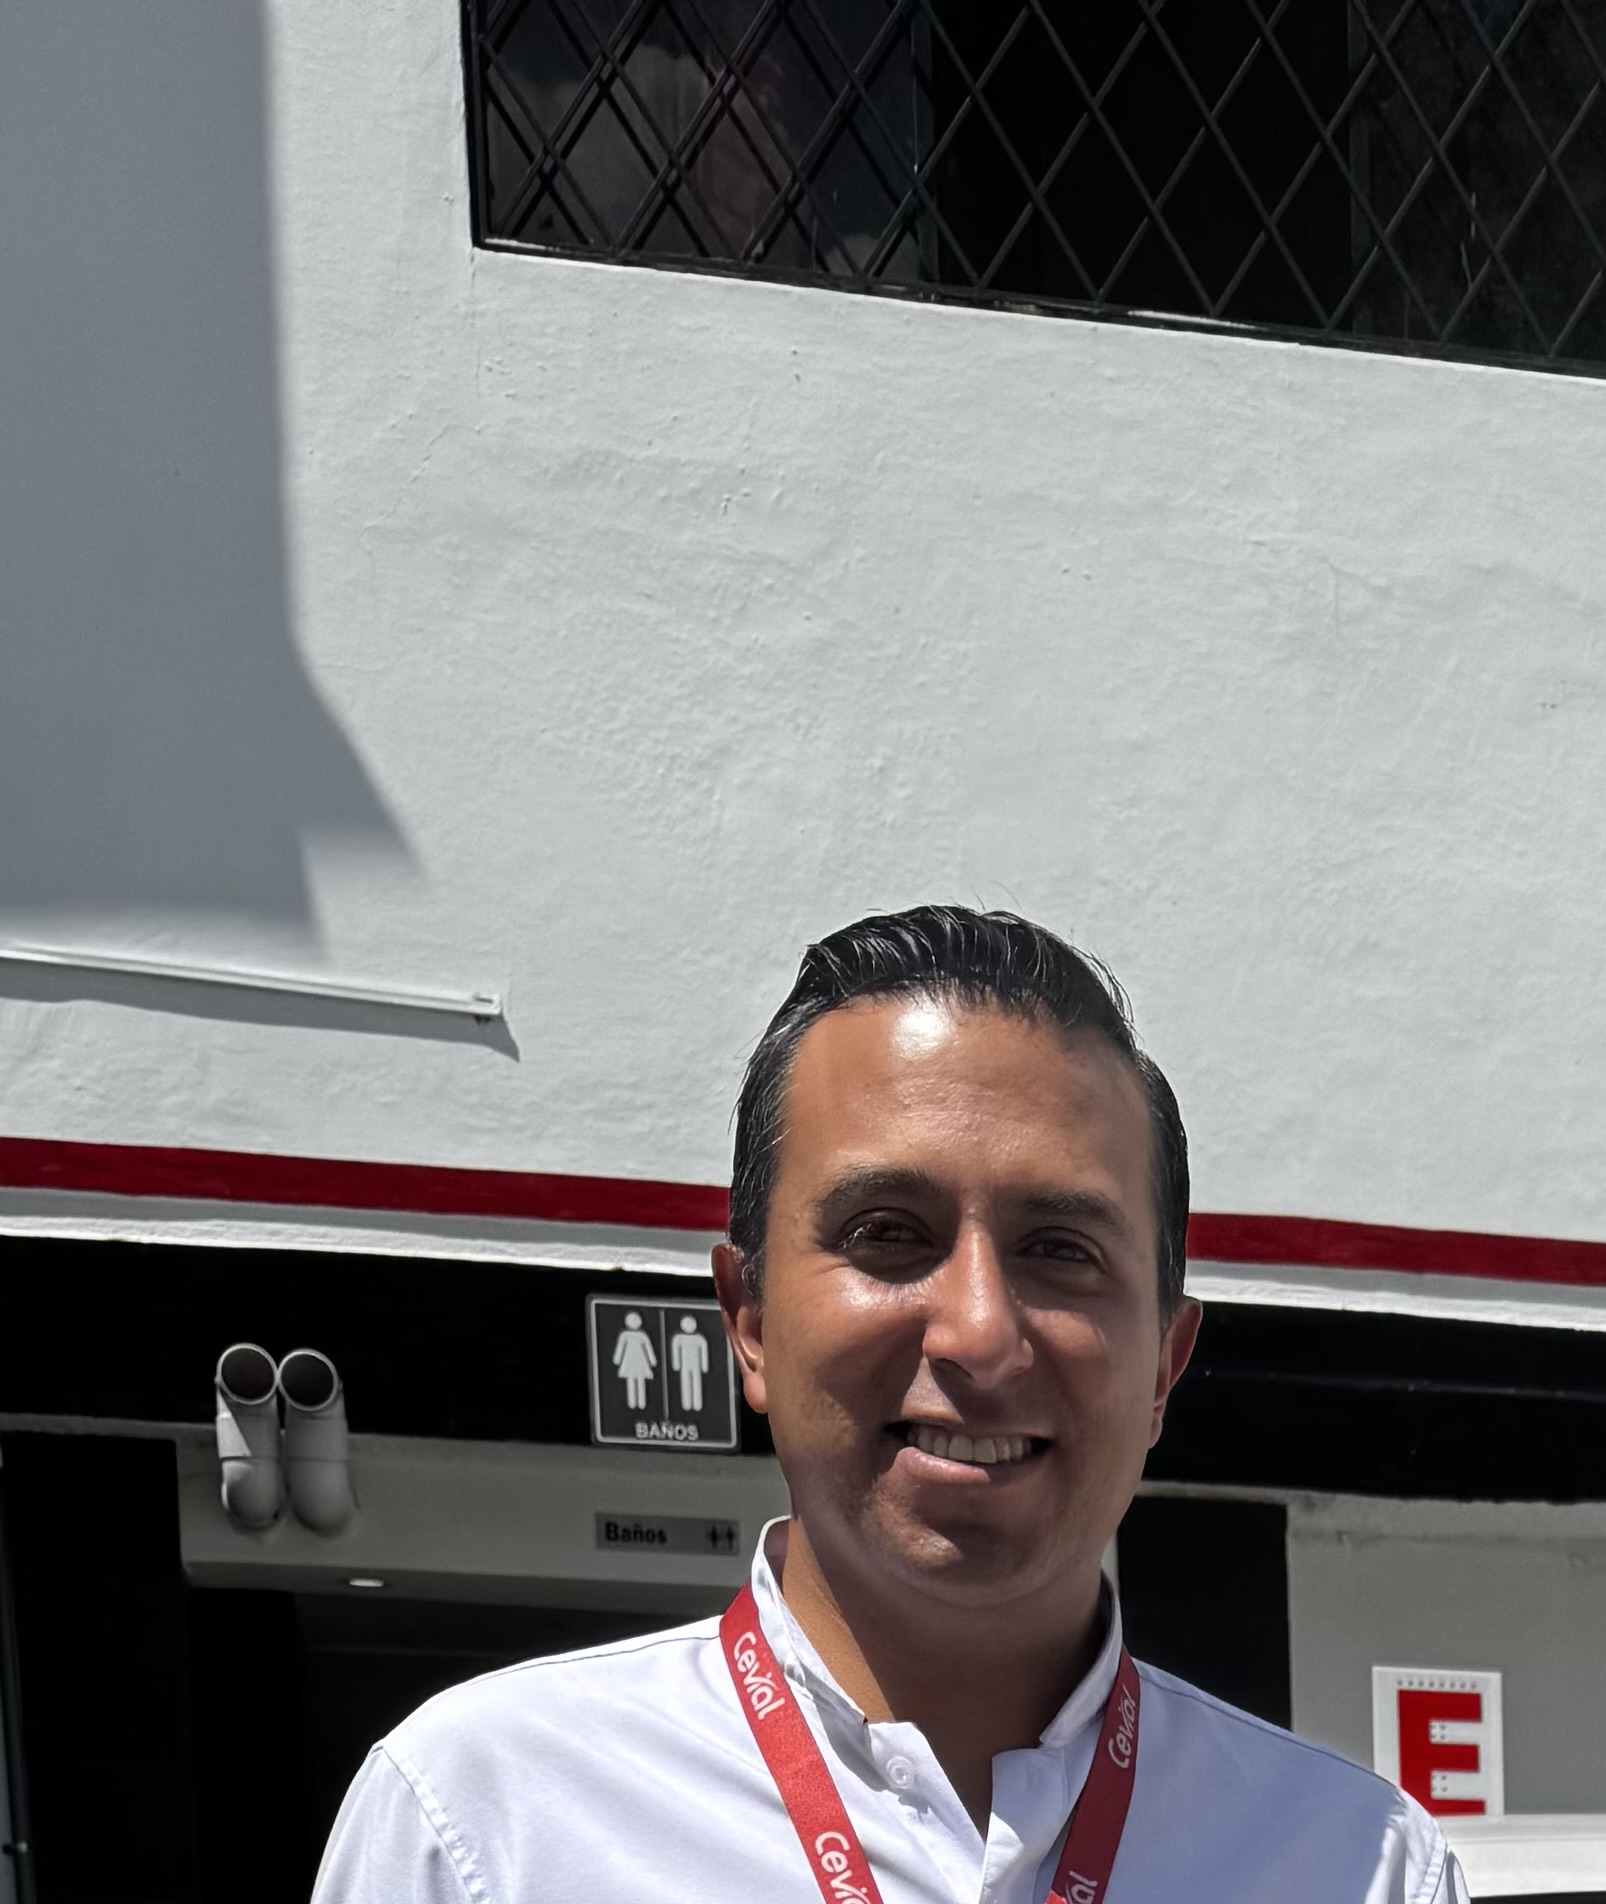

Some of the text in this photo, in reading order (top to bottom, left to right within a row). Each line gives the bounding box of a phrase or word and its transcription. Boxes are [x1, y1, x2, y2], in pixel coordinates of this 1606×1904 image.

[635, 1421, 699, 1441] BAÑOS
[605, 1521, 667, 1545] Baños
[733, 1631, 785, 1720] Cevial
[1108, 1684, 1137, 1769] Cevial
[1397, 1689, 1486, 1818] E
